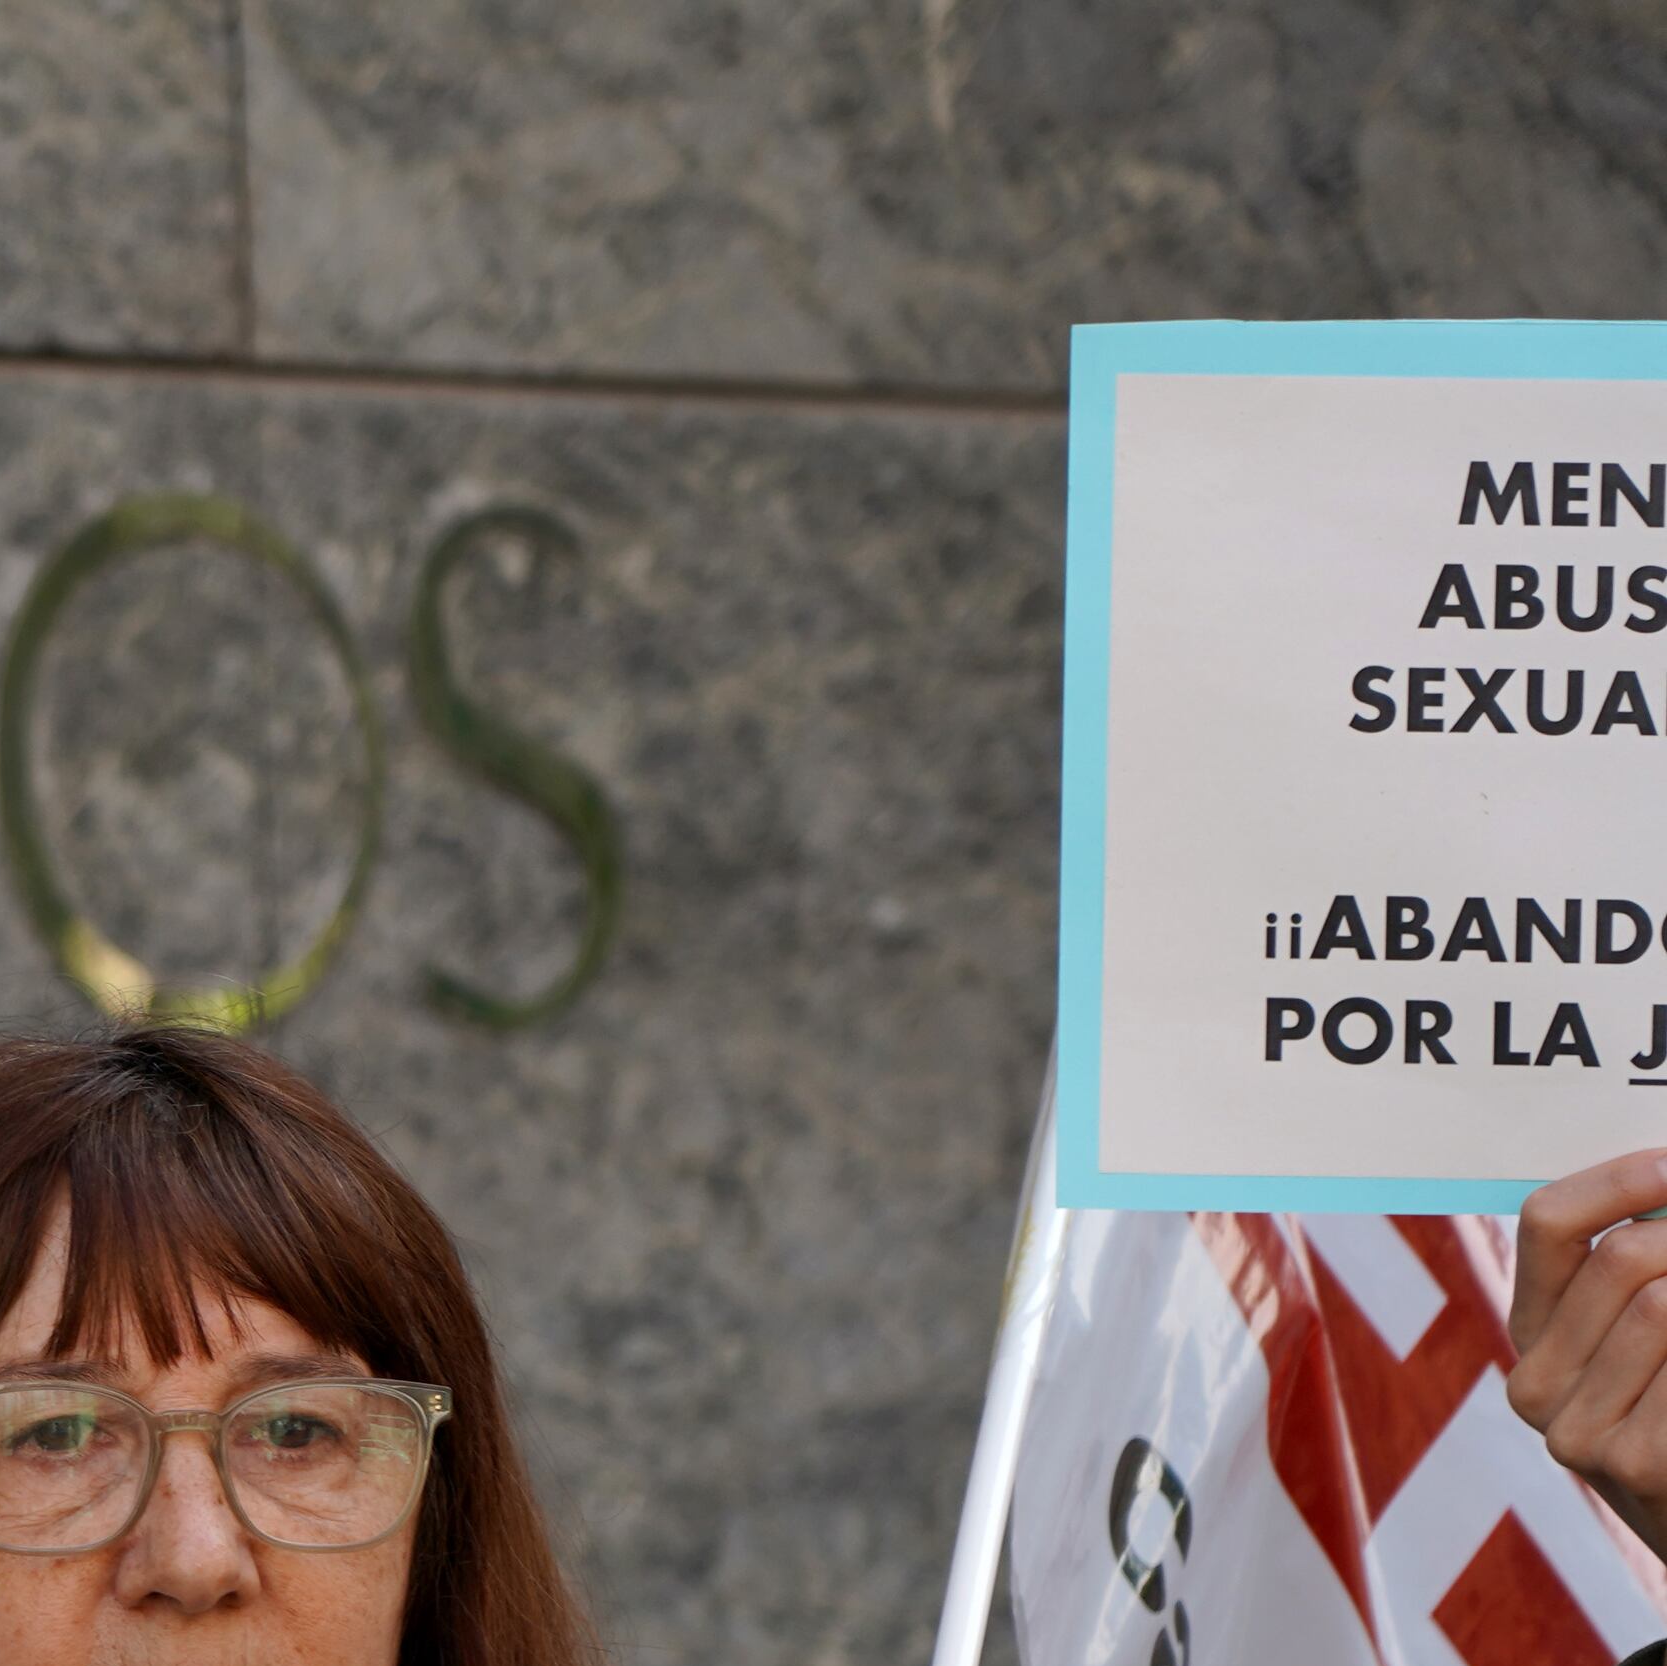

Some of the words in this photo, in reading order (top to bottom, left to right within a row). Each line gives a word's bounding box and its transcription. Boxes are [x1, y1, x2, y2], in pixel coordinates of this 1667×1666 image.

[1349, 666, 1667, 736] SEXUA
[1265, 997, 1457, 1065] POR
[1493, 1001, 1600, 1067] LA
